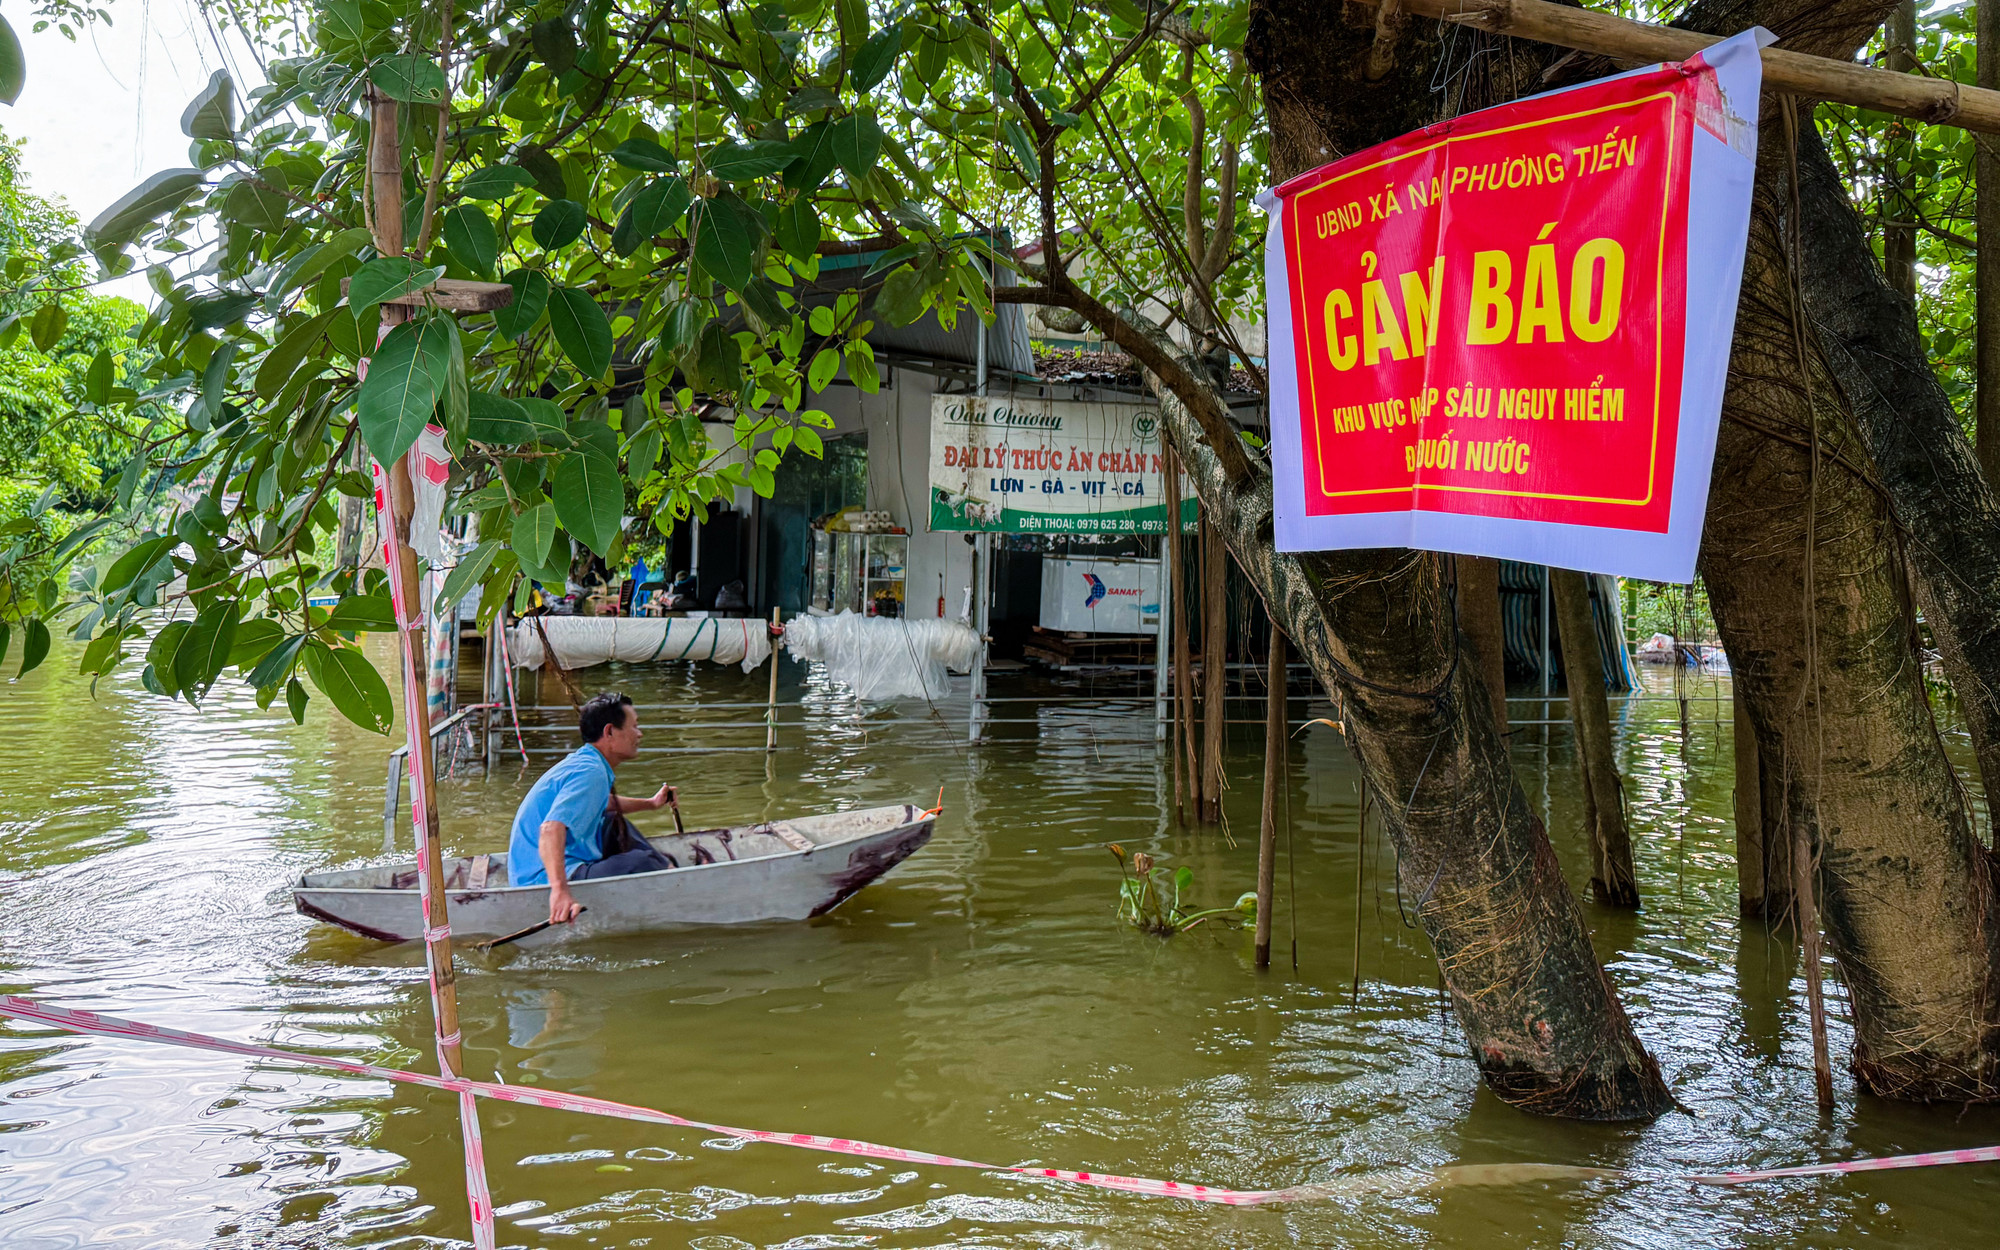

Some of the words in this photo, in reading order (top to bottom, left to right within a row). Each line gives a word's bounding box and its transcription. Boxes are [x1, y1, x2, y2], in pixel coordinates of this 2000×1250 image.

[1316, 201, 1362, 240] UBND
[1370, 183, 1402, 222] XÃ
[1449, 152, 1566, 194] PHƯƠNG
[1573, 125, 1638, 177] TIẾN
[1466, 221, 1626, 345] BÁO
[993, 406, 1063, 431] Chương
[1333, 400, 1363, 433] KHU
[1368, 399, 1407, 434] VỰC
[1444, 381, 1492, 419] SÂU
[1497, 387, 1558, 421] NGUY
[1565, 373, 1625, 422] HIỂM
[944, 445, 979, 473] ĐẠI
[983, 442, 1007, 469] LÝ
[1011, 445, 1063, 471] THỨC
[1066, 446, 1094, 472] ĂN
[1098, 447, 1147, 473] CHĂN
[1465, 436, 1531, 475] NƯỚC
[990, 477, 1025, 496] LỢN
[1082, 481, 1107, 498] VỊT
[1123, 479, 1145, 496] CÁ
[1019, 515, 1042, 531] ĐIỆN
[1043, 517, 1075, 533] THOẠI:
[1077, 518, 1099, 530] 0979
[1100, 519, 1117, 530] 625
[1119, 519, 1136, 531] 280
[1107, 587, 1145, 597] SANAKY
